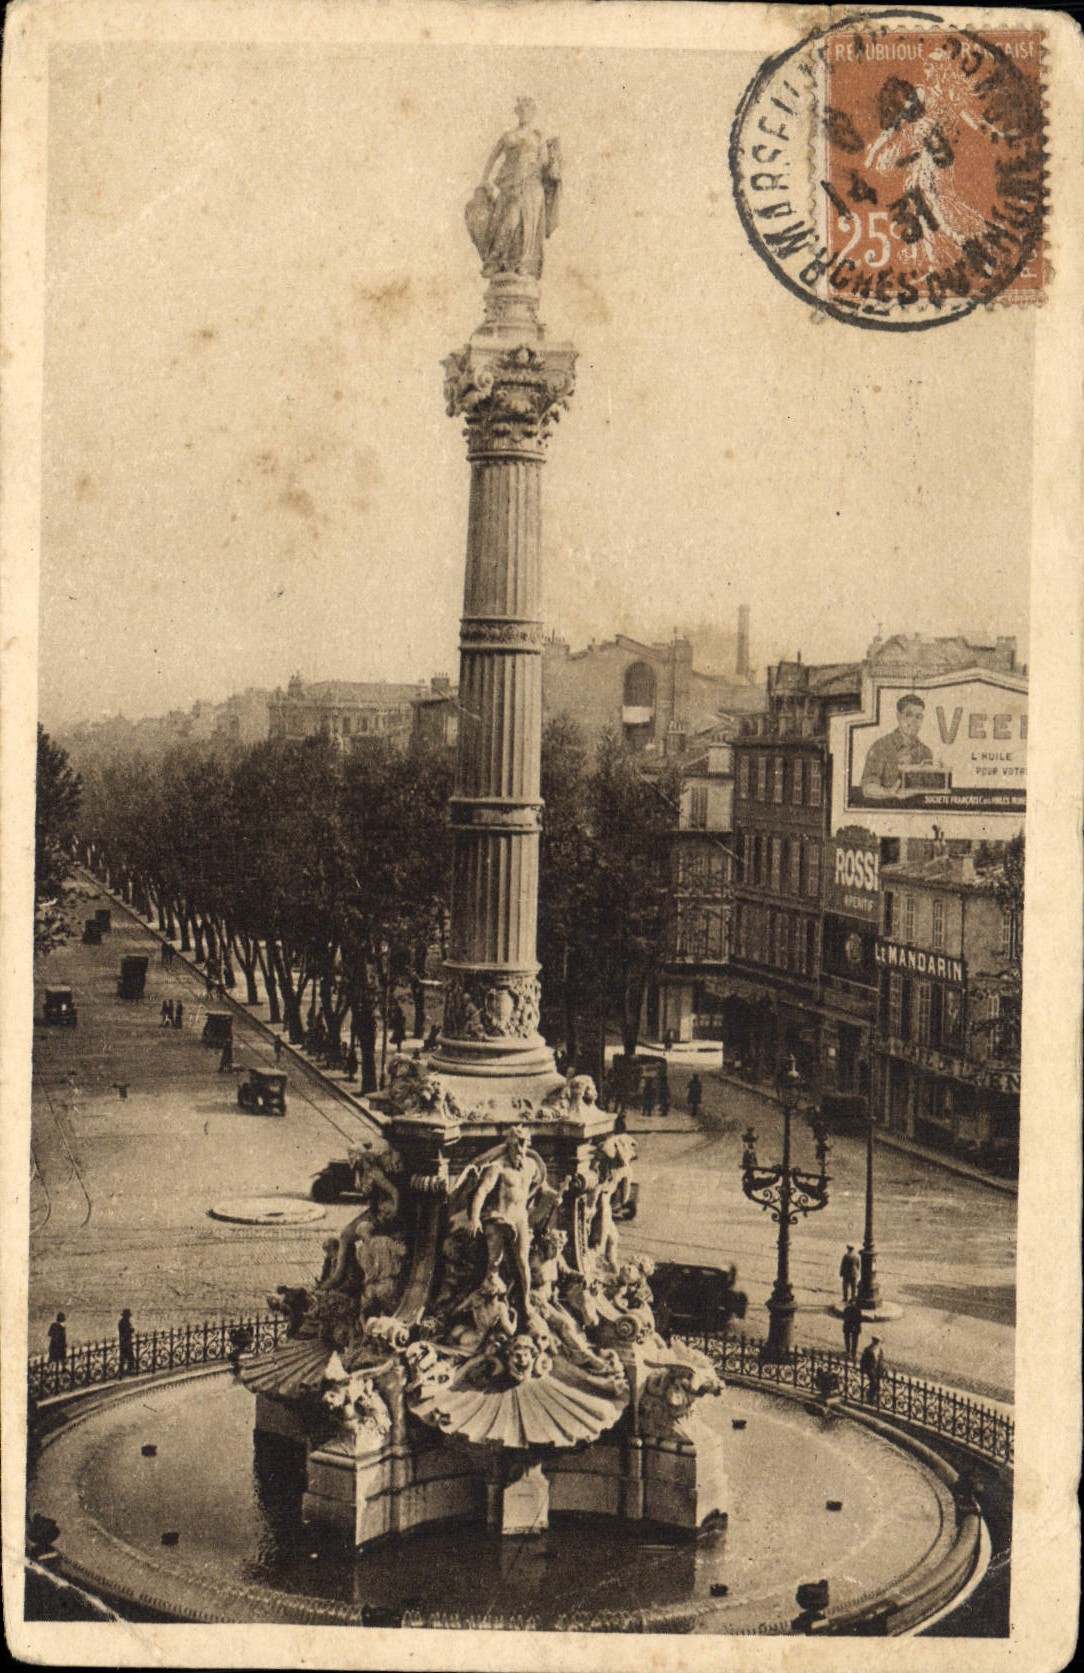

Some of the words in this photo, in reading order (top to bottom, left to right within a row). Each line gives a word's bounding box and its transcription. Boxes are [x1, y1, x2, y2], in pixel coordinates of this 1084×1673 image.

[834, 42, 924, 61] REUBLIQUE
[971, 752, 1013, 761] L'HUILE
[976, 767, 998, 776] POUR
[834, 847, 879, 892] ROSSI
[888, 945, 963, 982] MANDARIN
